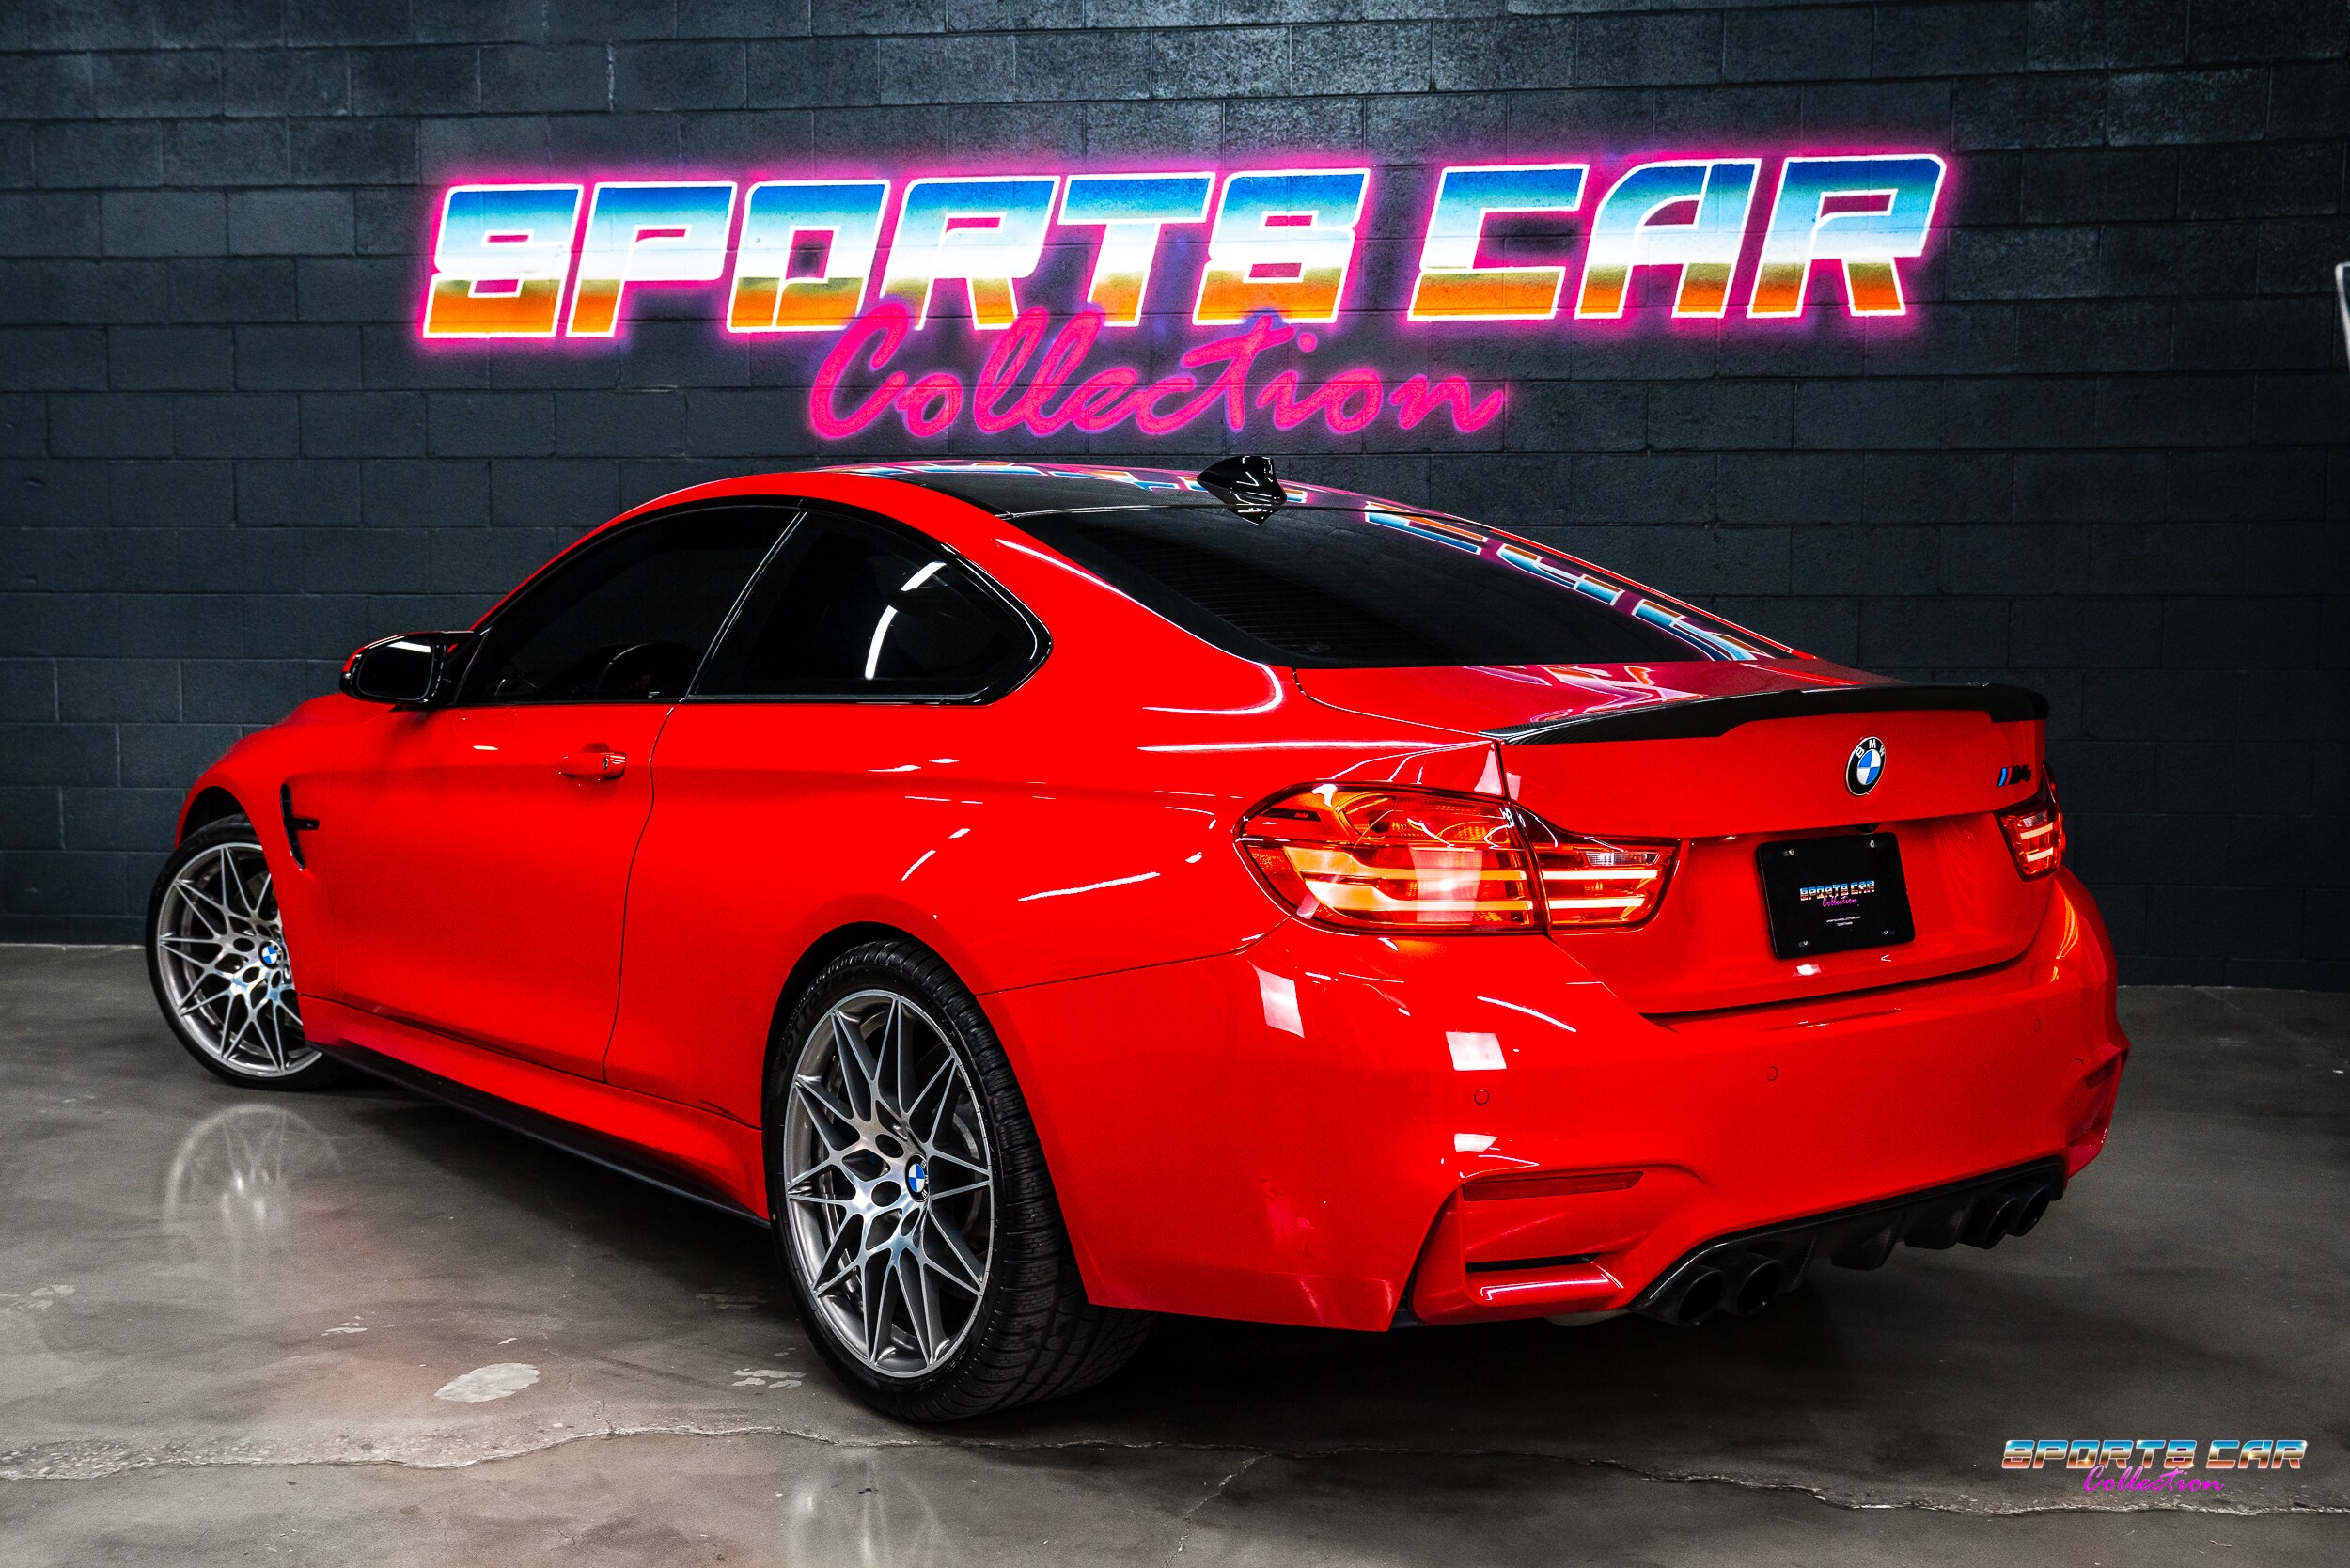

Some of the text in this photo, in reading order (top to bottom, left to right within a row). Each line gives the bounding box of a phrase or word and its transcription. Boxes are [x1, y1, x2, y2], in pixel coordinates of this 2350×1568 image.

[422, 153, 1948, 339] SPORTS CAR
[809, 301, 1505, 440] Collection
[1855, 738, 1886, 759] BMW
[1799, 880, 1875, 902] SPORTS CAR
[1822, 895, 1858, 908] Collection
